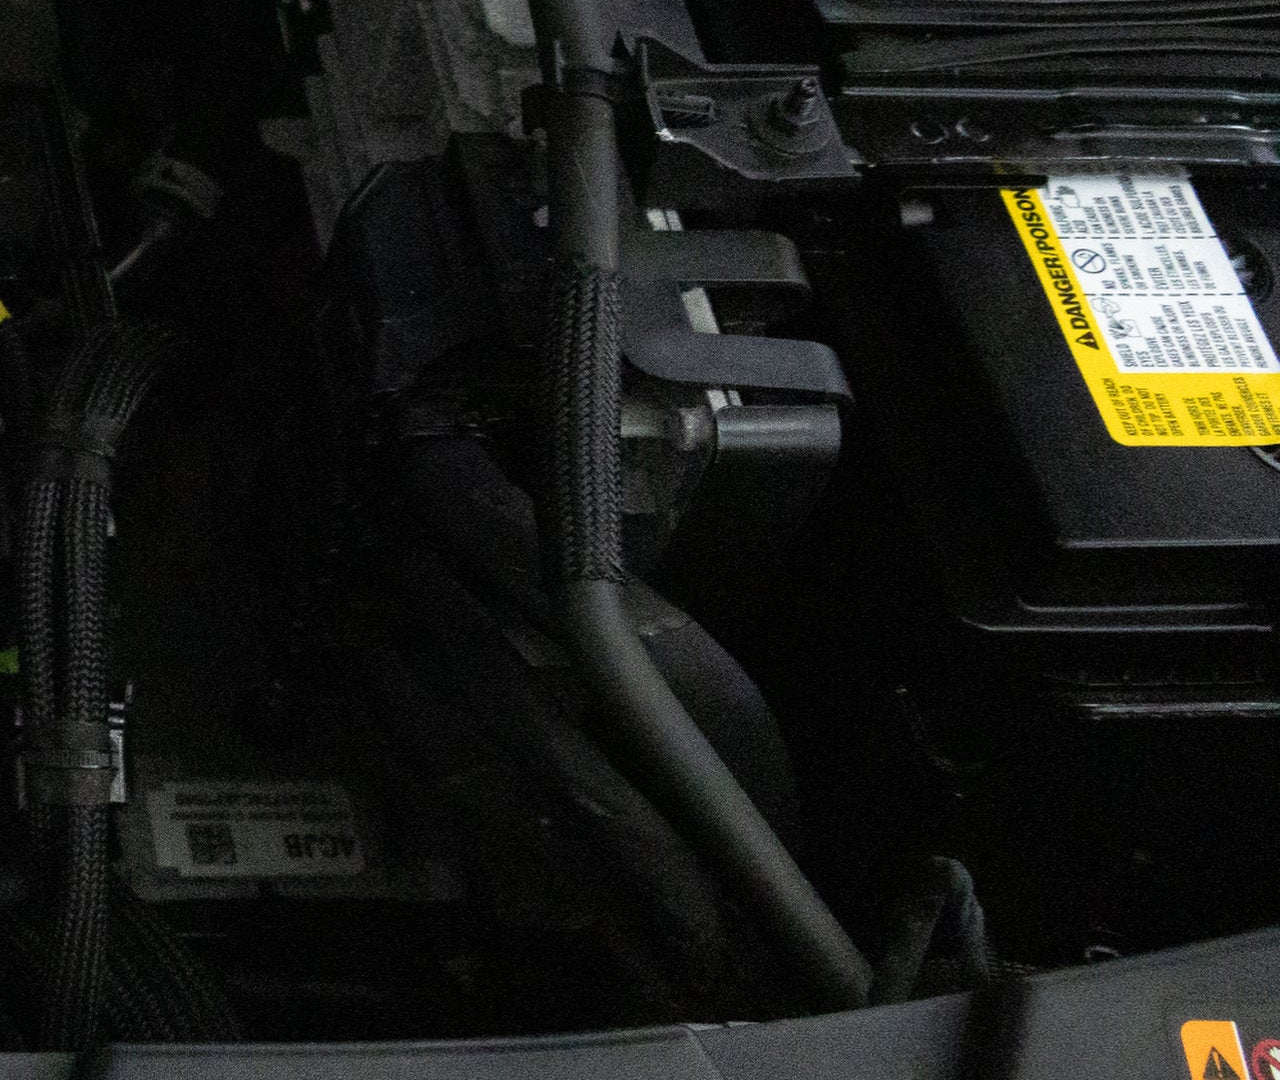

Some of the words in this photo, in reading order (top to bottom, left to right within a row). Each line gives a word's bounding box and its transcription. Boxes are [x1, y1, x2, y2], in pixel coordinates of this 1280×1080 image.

[1010, 188, 1090, 329] DANGER/POISON
[1102, 281, 1115, 289] NO
[1178, 301, 1195, 317] YEUX
[1186, 320, 1203, 331] LES
[1161, 336, 1174, 347] CAN
[1116, 344, 1138, 366] SHIELD
[1136, 351, 1154, 366] EYES
[1222, 357, 1236, 367] LES
[1103, 378, 1119, 396] REACH
[1136, 388, 1150, 398] NOT
[1155, 394, 1175, 417] BATTERY
[1116, 408, 1131, 419] OUT
[1122, 422, 1137, 435] KEEP
[1154, 425, 1167, 435] NOT
